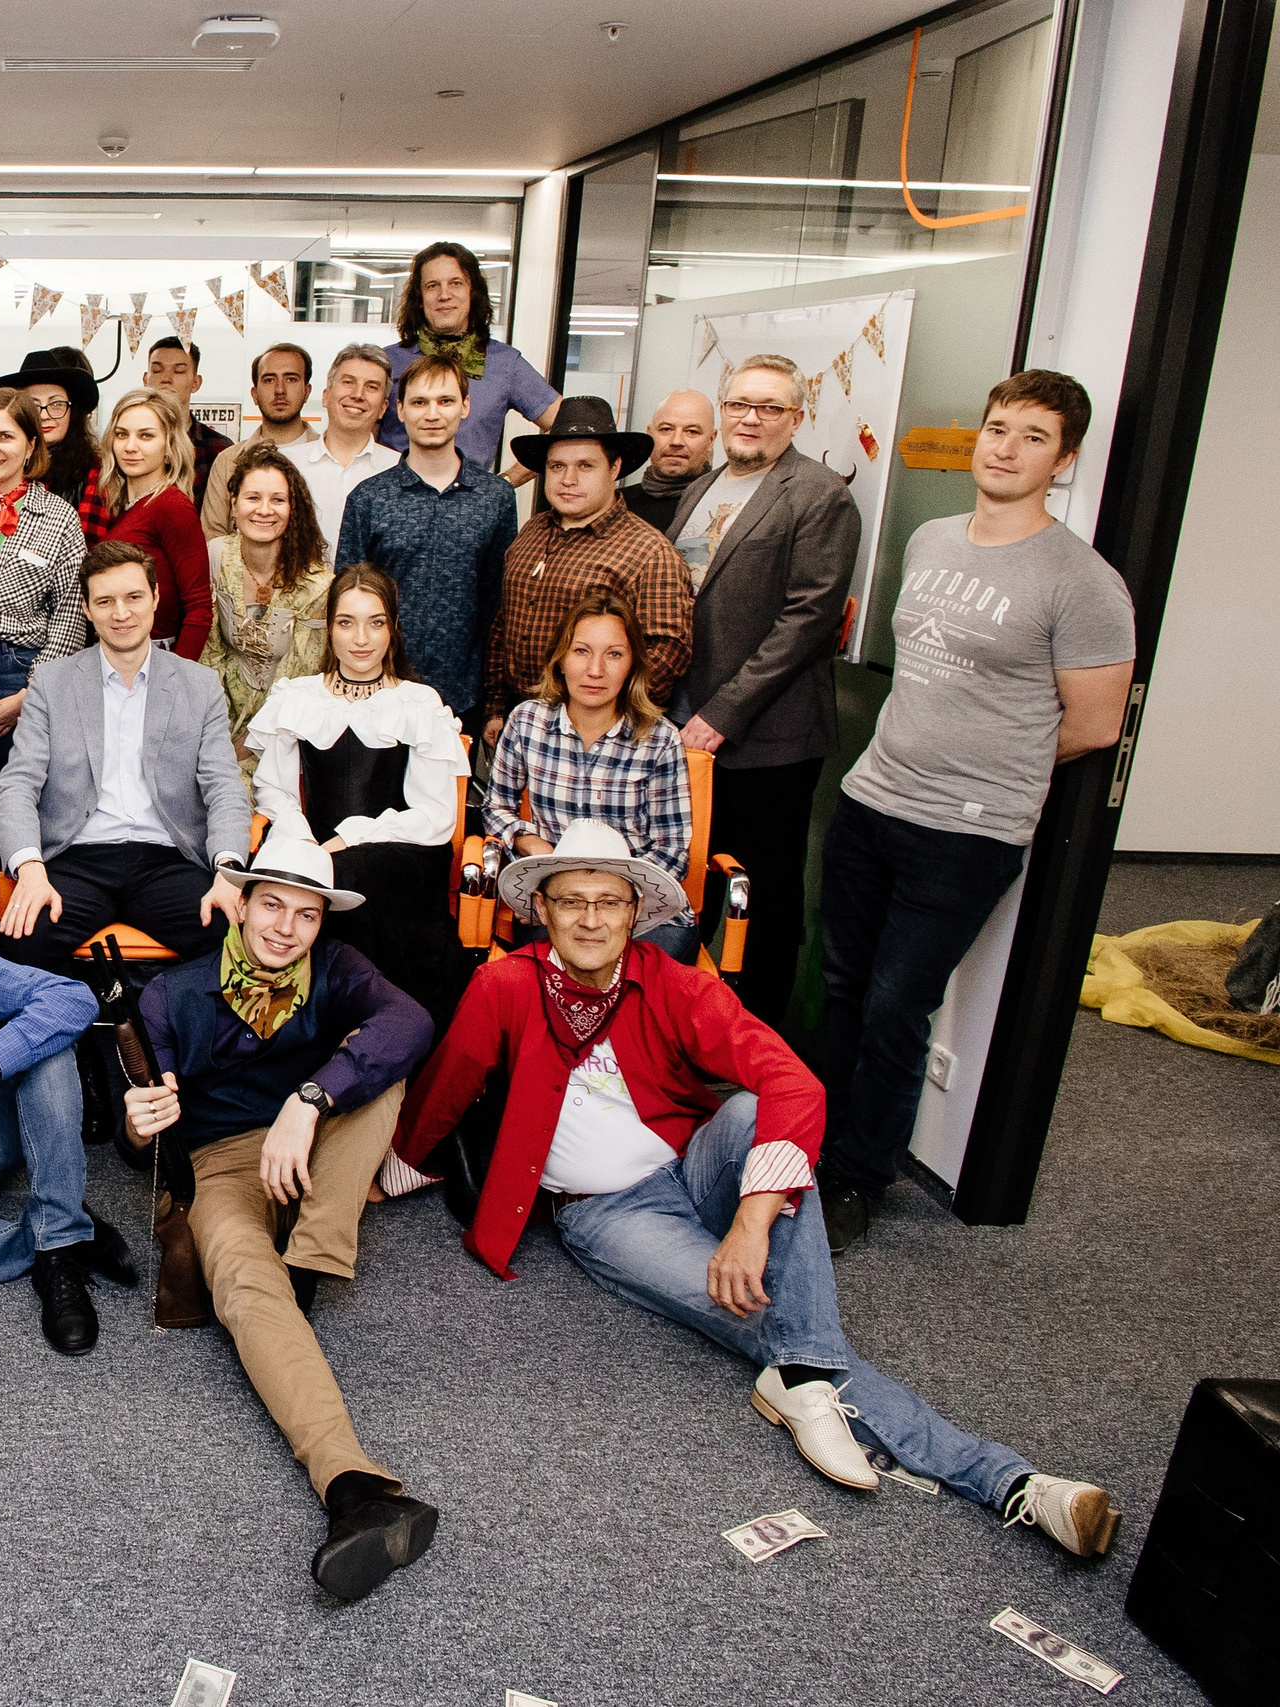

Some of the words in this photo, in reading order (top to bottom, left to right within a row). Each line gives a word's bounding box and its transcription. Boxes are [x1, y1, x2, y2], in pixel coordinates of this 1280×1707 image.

[190, 409, 235, 422] ANTED
[900, 569, 1011, 625] OUTDOOR
[572, 1055, 619, 1075] ARD
